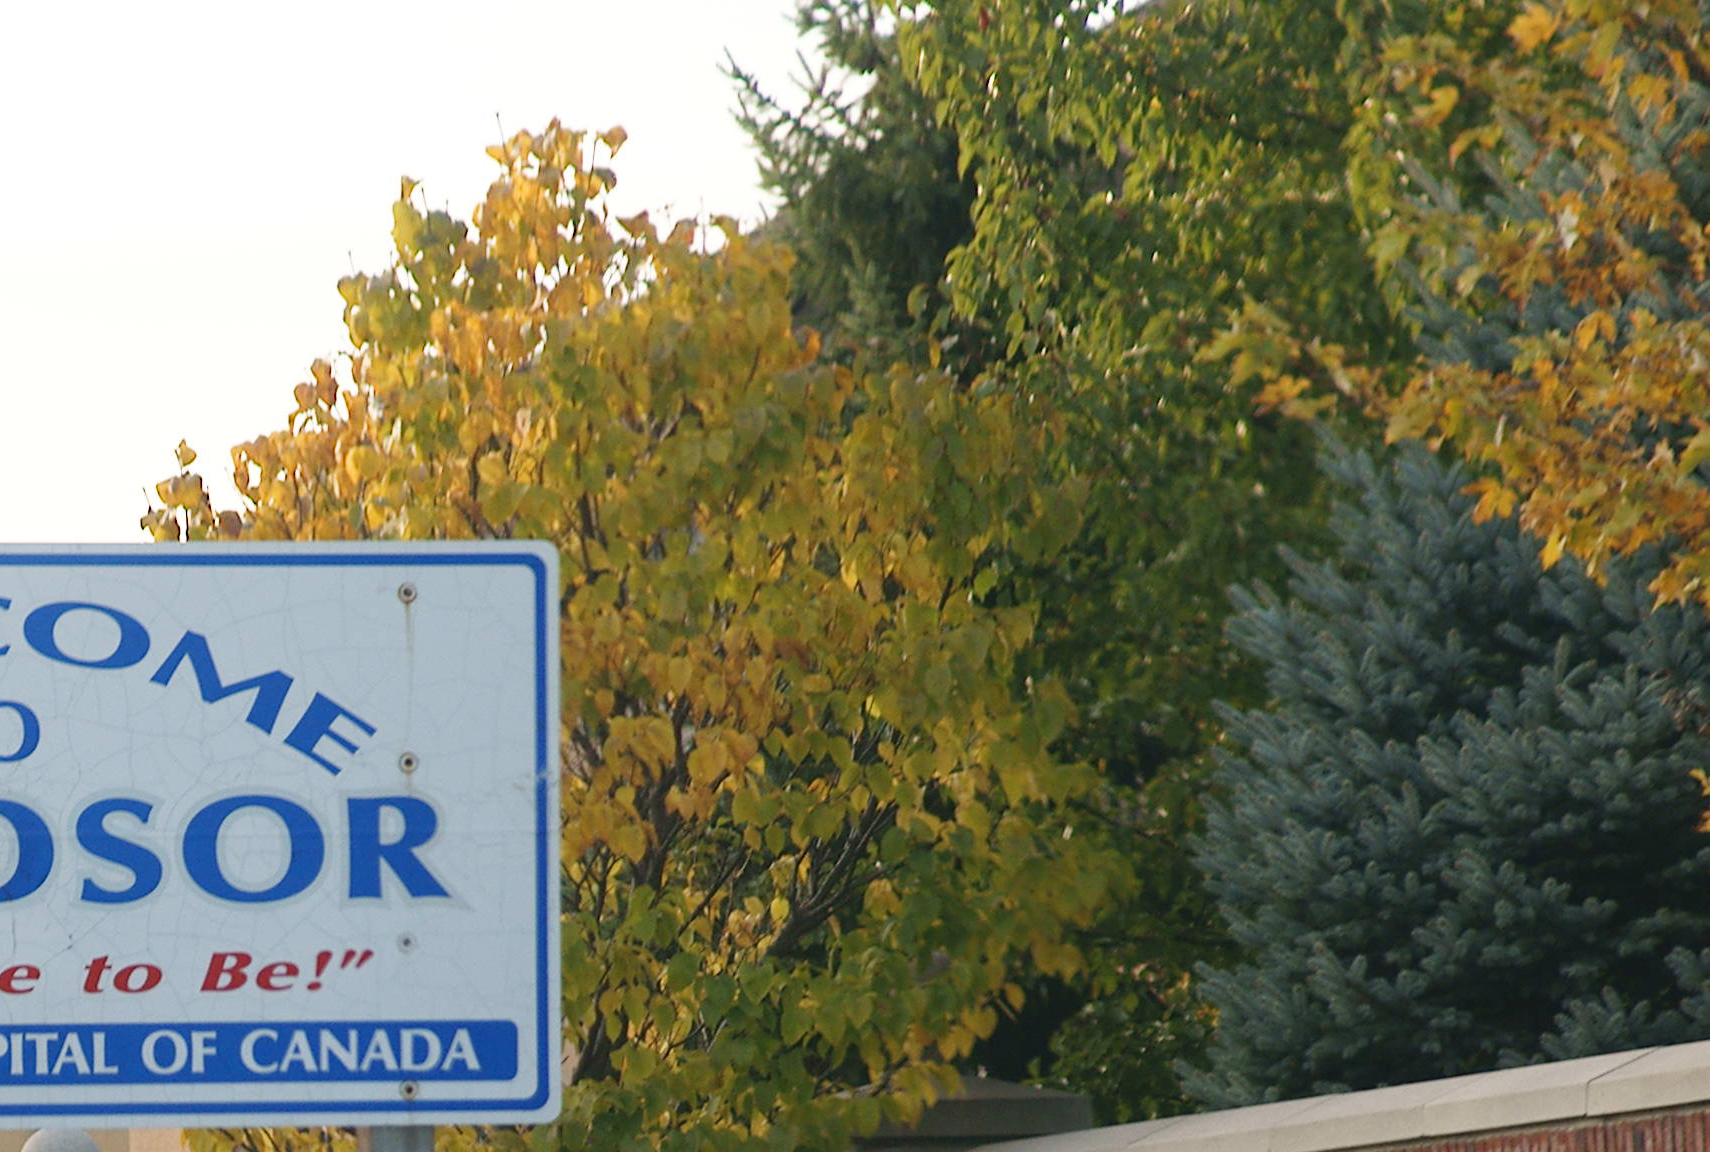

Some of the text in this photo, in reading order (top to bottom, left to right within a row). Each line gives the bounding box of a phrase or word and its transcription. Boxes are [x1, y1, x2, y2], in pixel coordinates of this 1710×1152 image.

[83, 955, 163, 994] to
[141, 1029, 217, 1075] OF
[240, 1028, 481, 1075] CANADA
